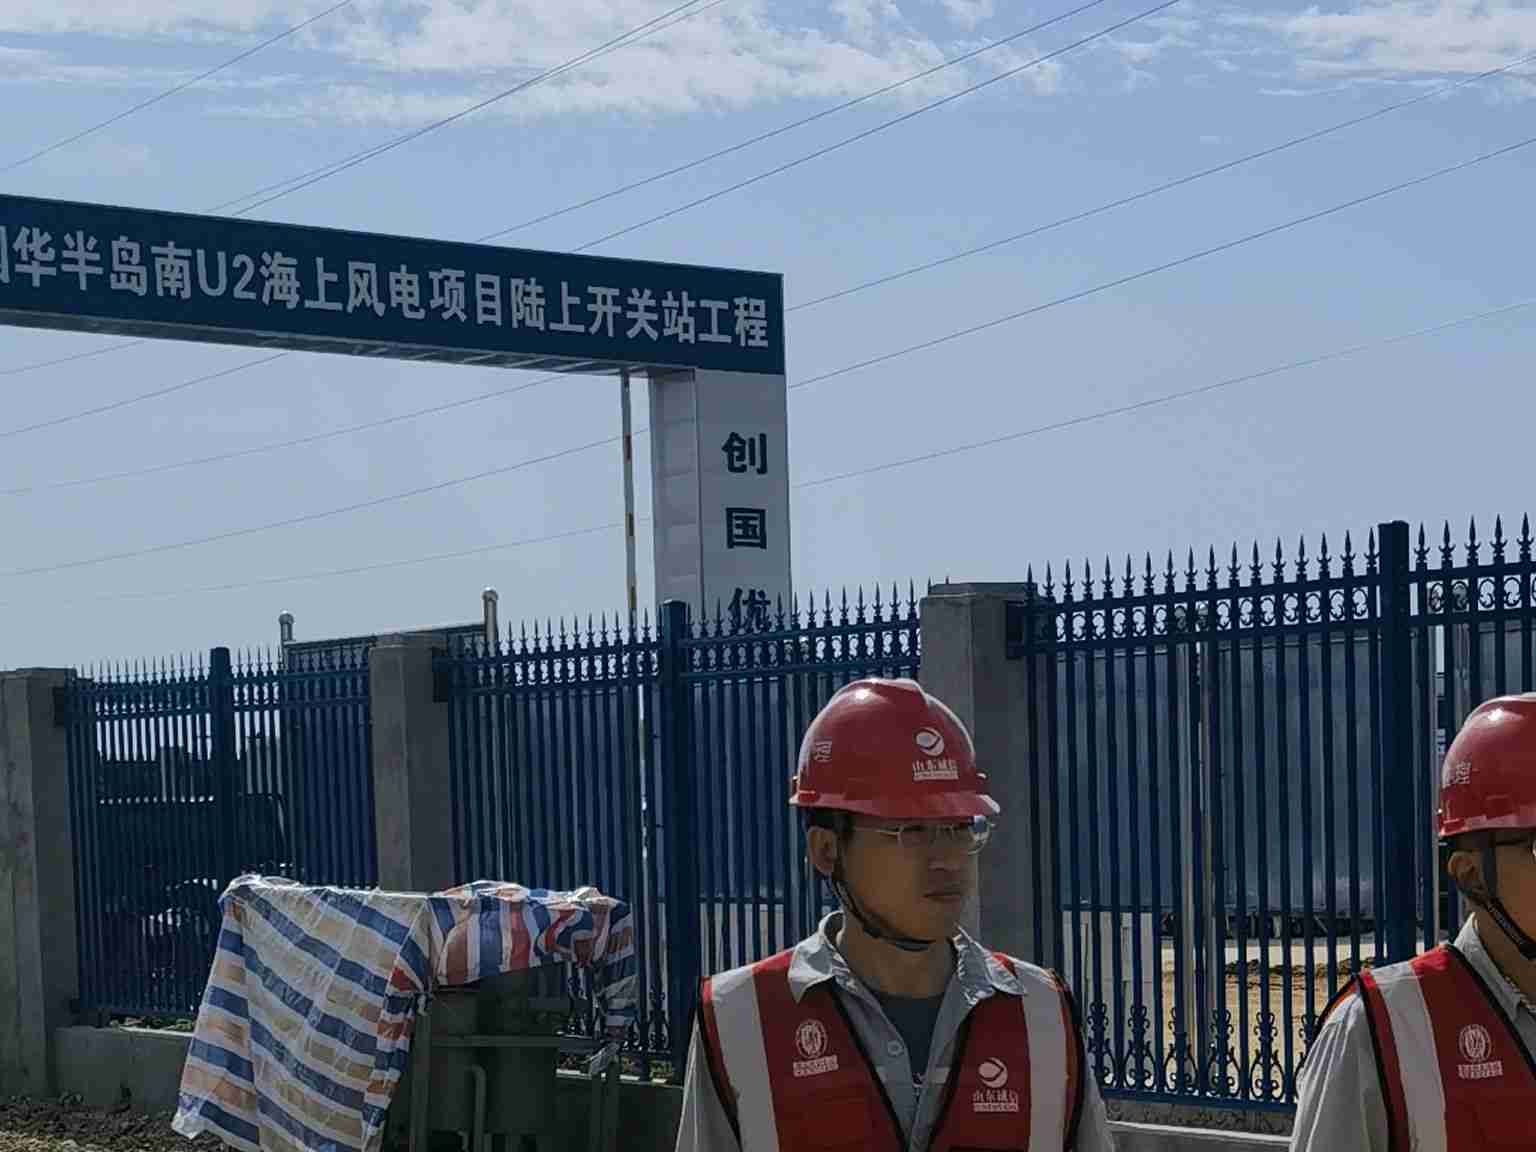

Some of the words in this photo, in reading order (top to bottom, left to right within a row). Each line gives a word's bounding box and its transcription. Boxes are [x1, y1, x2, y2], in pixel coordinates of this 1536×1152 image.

[0, 225, 769, 347] 华半岛南U2海上风电项目陆上开关站工程
